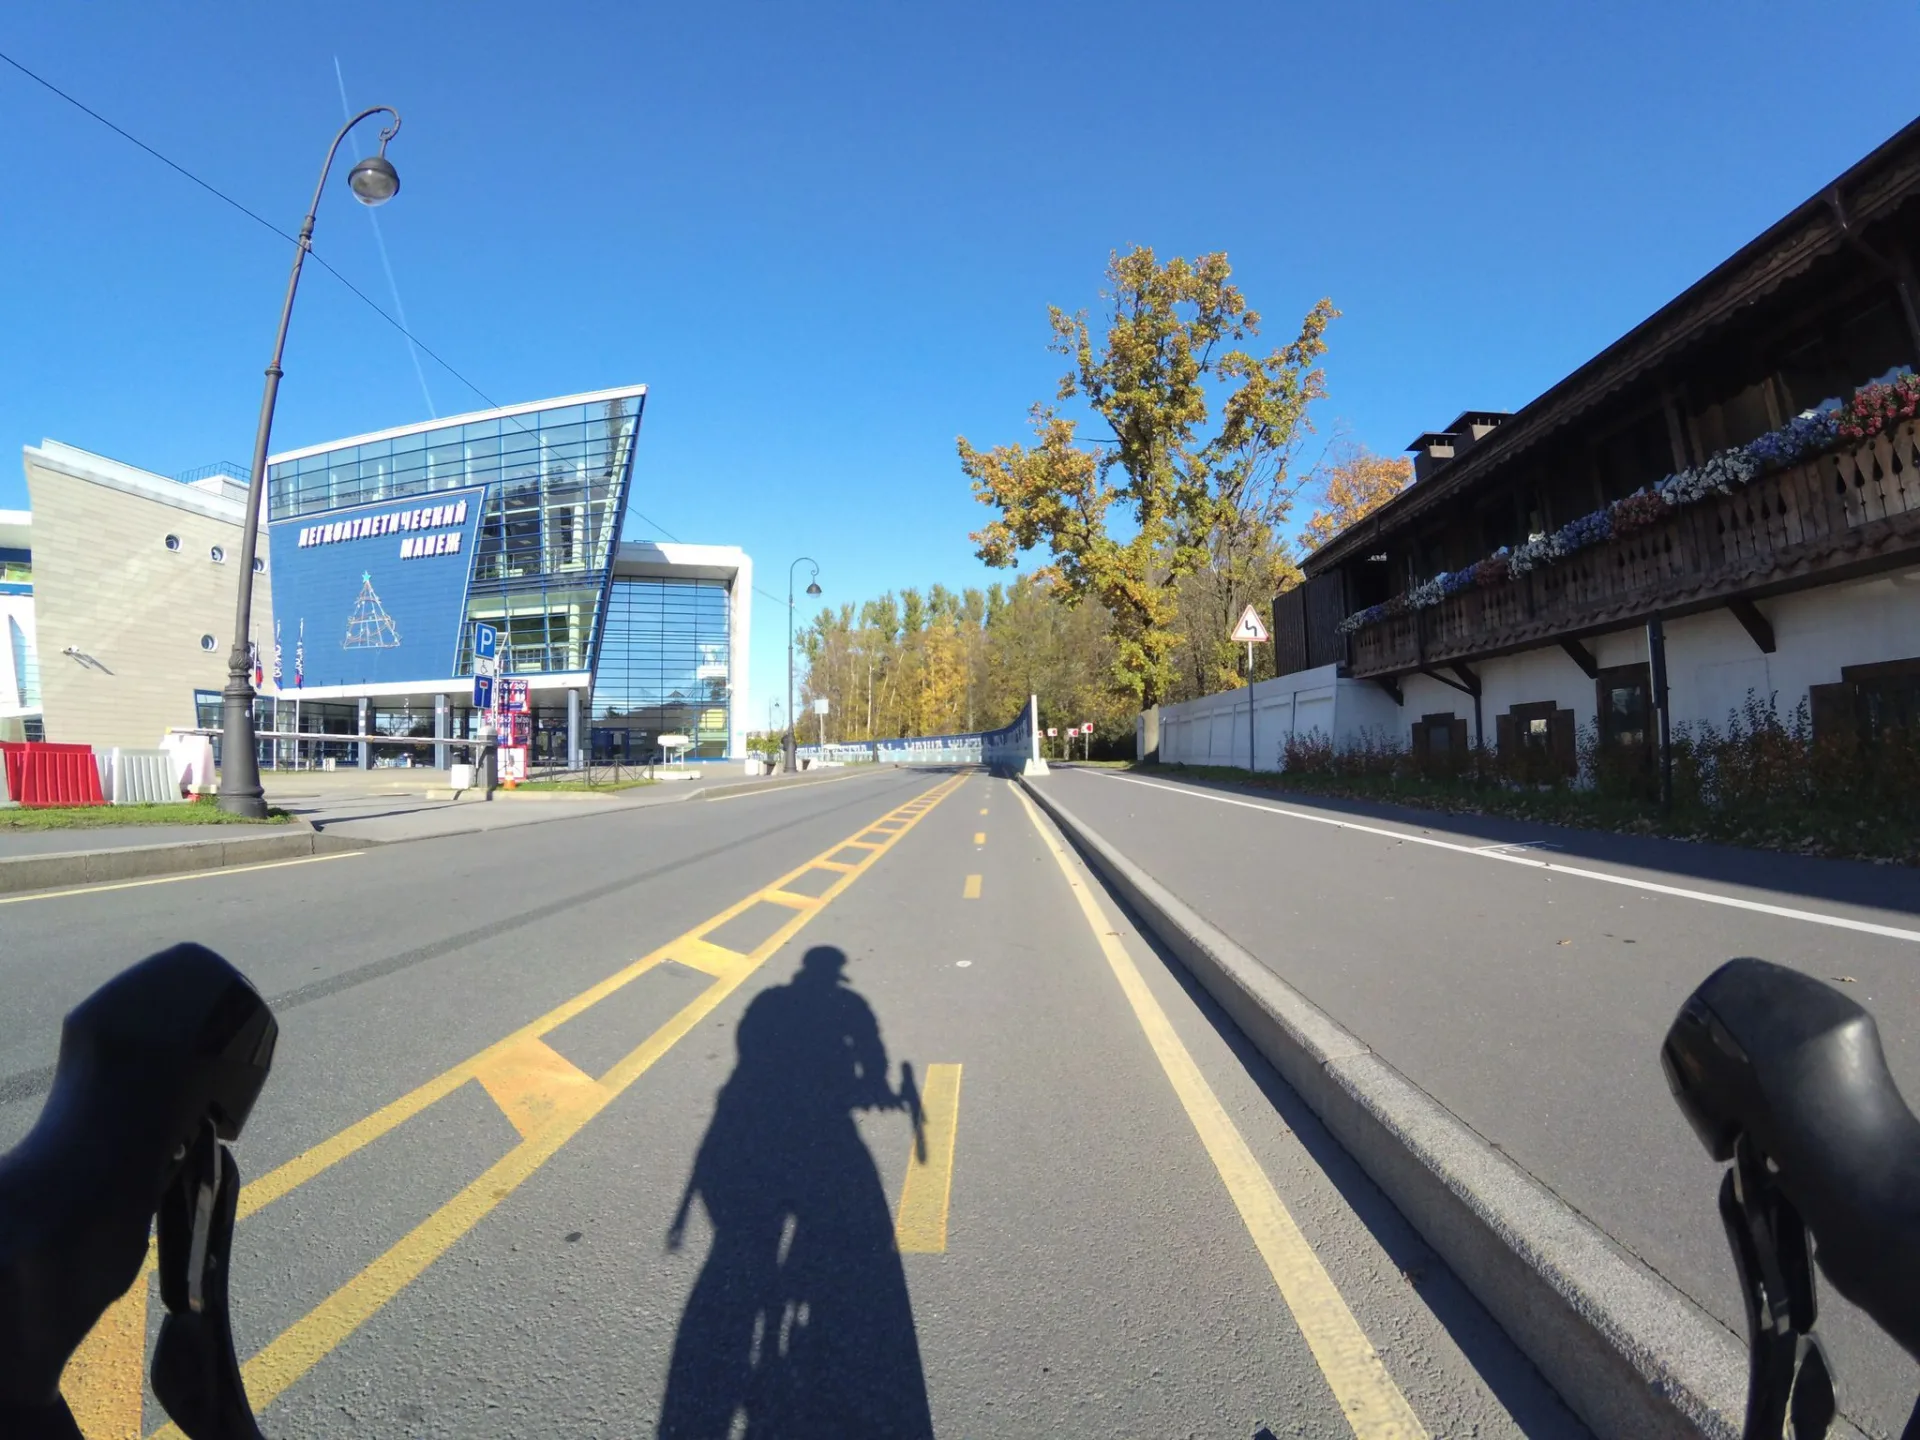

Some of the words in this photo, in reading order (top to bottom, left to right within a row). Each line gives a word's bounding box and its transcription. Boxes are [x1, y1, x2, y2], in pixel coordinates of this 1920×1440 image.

[298, 499, 467, 548] ЛЕГКОАТЛЕТИЧЕСКИЙ
[400, 532, 462, 560] МАНЕЖ
[481, 628, 493, 653] P
